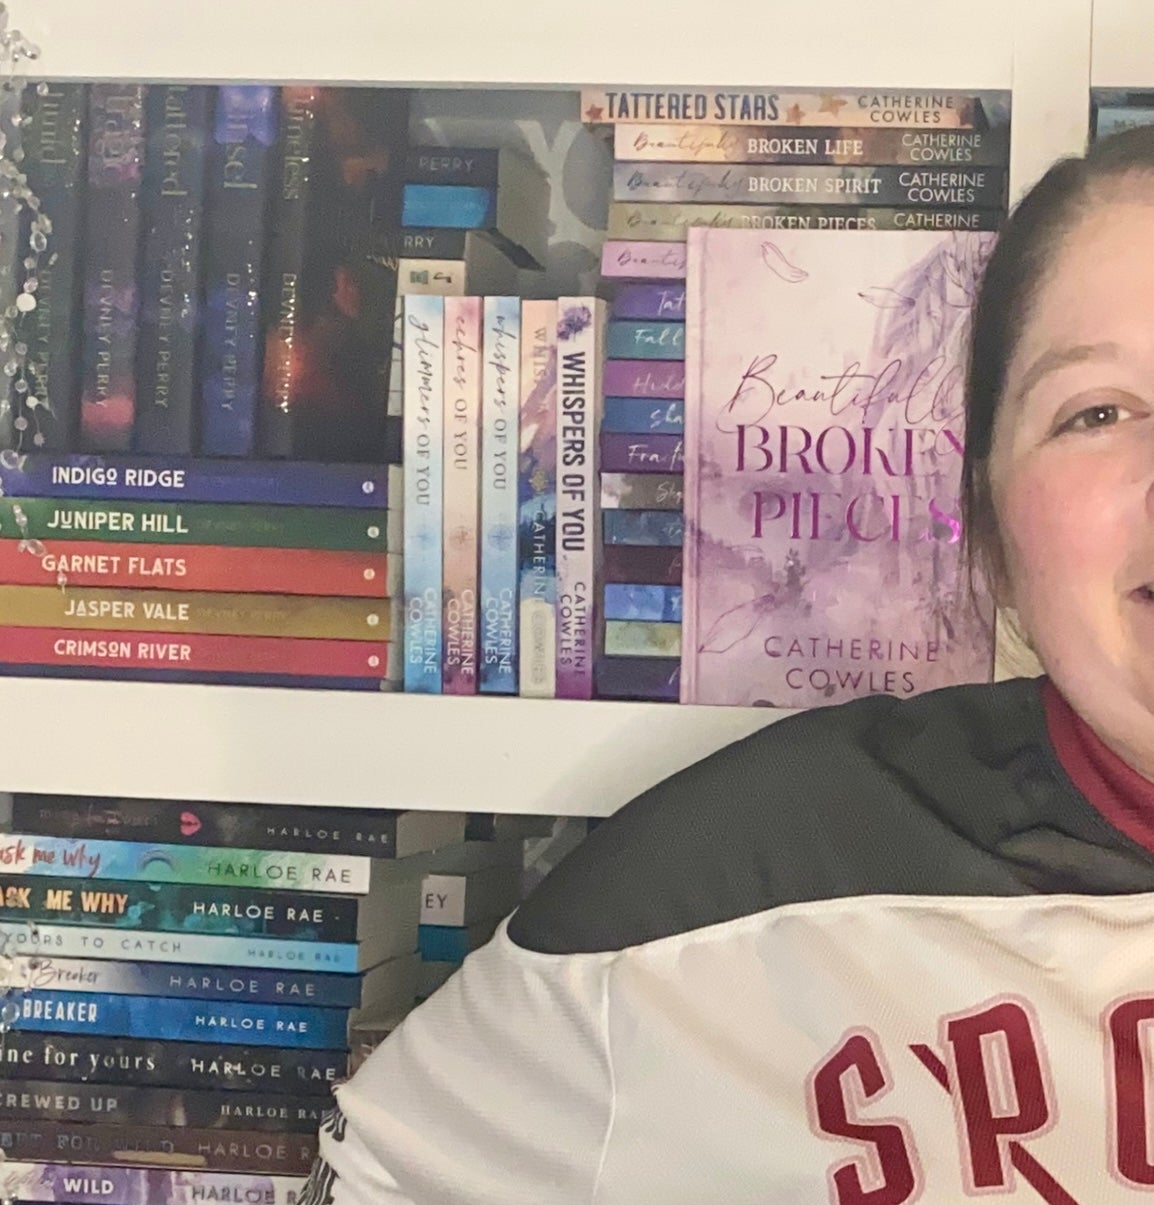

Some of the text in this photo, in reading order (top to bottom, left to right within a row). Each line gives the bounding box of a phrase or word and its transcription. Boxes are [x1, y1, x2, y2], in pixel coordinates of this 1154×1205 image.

[606, 92, 780, 121] TATTERED STARS
[857, 95, 953, 110] CATHERINE
[870, 109, 941, 124] COWLES
[748, 138, 863, 156] BROKEN LIFE
[902, 133, 982, 148] CATHERINE
[910, 147, 972, 162] COWLES
[749, 177, 882, 194] BROKEN SPIRIT
[899, 172, 985, 188] CATHERINE
[907, 187, 975, 203] COWLES
[454, 316, 476, 391] echoes
[488, 315, 513, 412] whispers
[408, 315, 435, 428] glimmers
[562, 352, 586, 551] WHISPERS OF YOU
[52, 467, 185, 488] INDIGO RIDGE
[47, 510, 188, 533] JUNIPER HILL
[42, 555, 187, 576] GARNET FLATS
[64, 600, 135, 619] JASPER
[143, 603, 189, 620] VALE
[54, 639, 191, 661] CRIMSON RIVER
[764, 636, 941, 662] CATHERINE
[786, 668, 915, 693] COWLES
[62, 847, 352, 883] why HARLOE RAE
[47, 890, 323, 923] ME WHY HARLOE RAE
[81, 935, 182, 953] TO CATCH
[170, 975, 316, 996] HARLOE RAE
[23, 1000, 308, 1032] BREAKER HARLOE RAE
[44, 1043, 156, 1073] for yours
[63, 1177, 114, 1195] WILD
